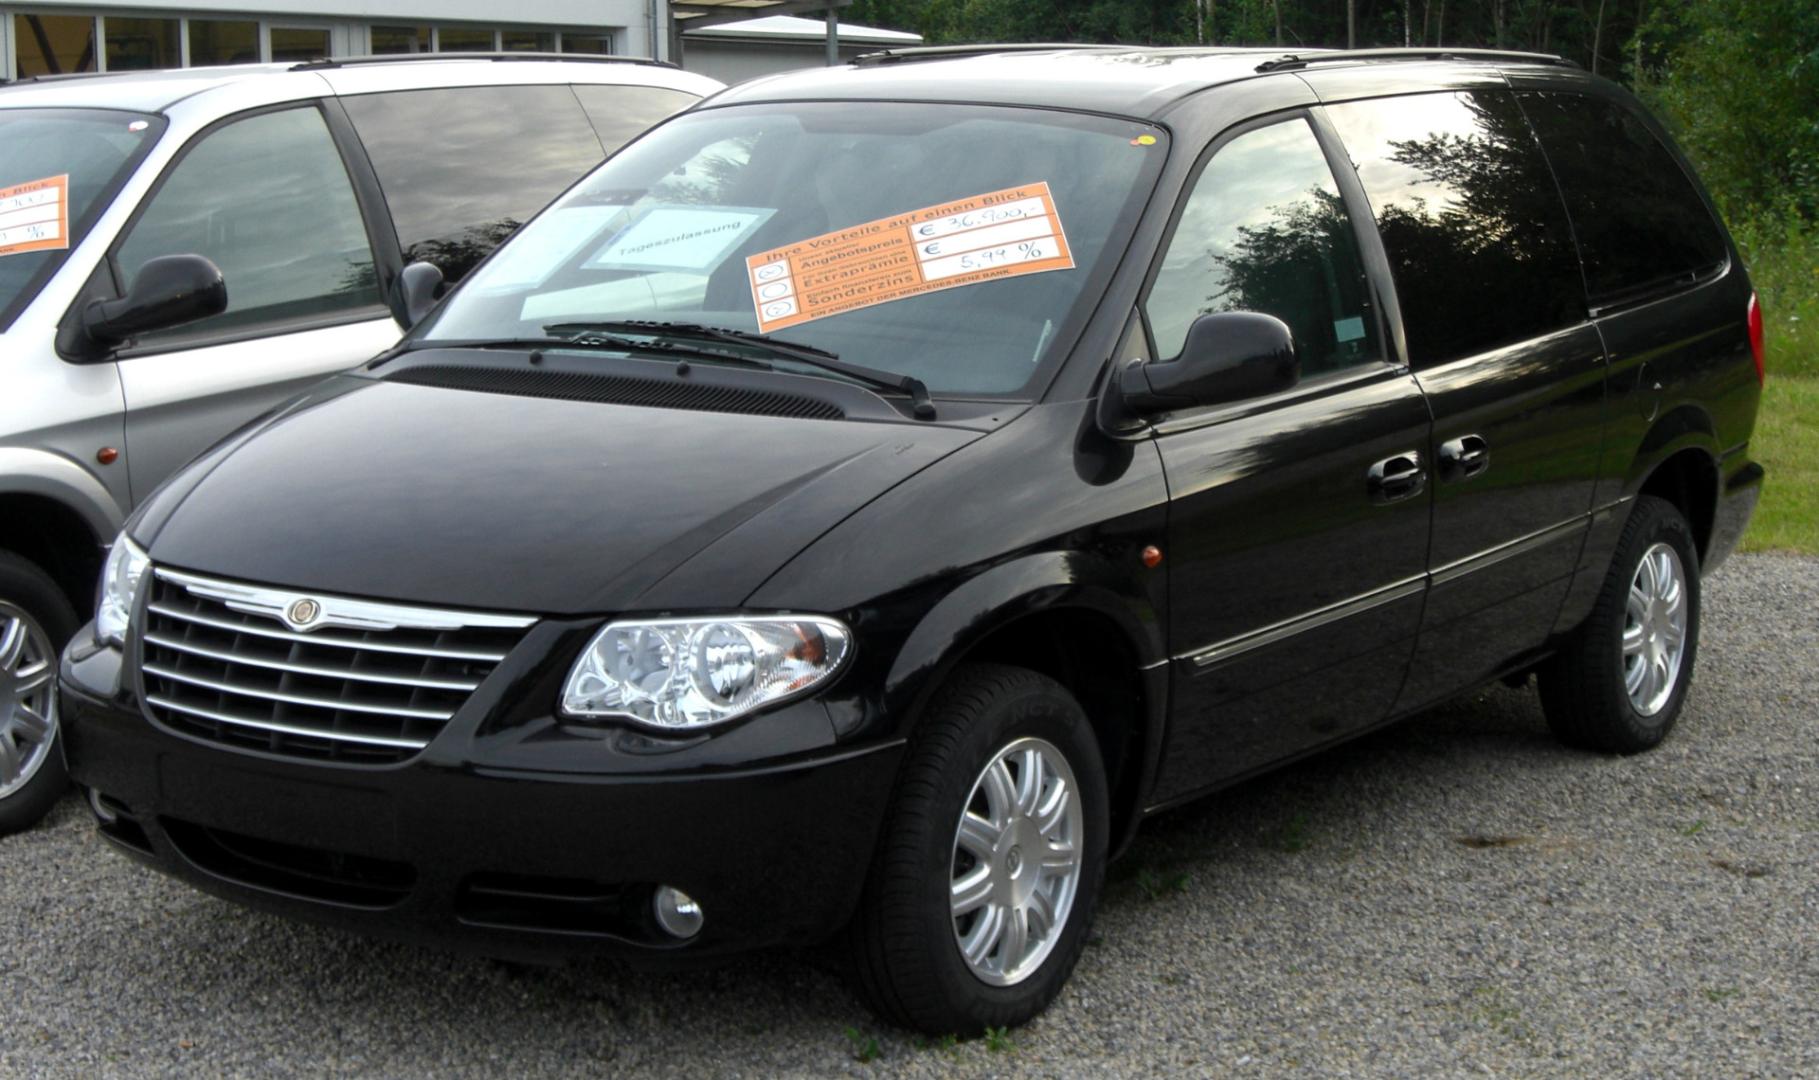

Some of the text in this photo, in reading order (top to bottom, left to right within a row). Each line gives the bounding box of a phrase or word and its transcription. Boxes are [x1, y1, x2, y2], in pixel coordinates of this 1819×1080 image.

[619, 220, 742, 256] Tageszulassung
[766, 190, 1027, 262] Ihre Vorteile auf einen Blick
[801, 238, 904, 269] Angebotspreis
[803, 256, 909, 288] Extraprämie
[808, 275, 914, 306] Sonderzins
